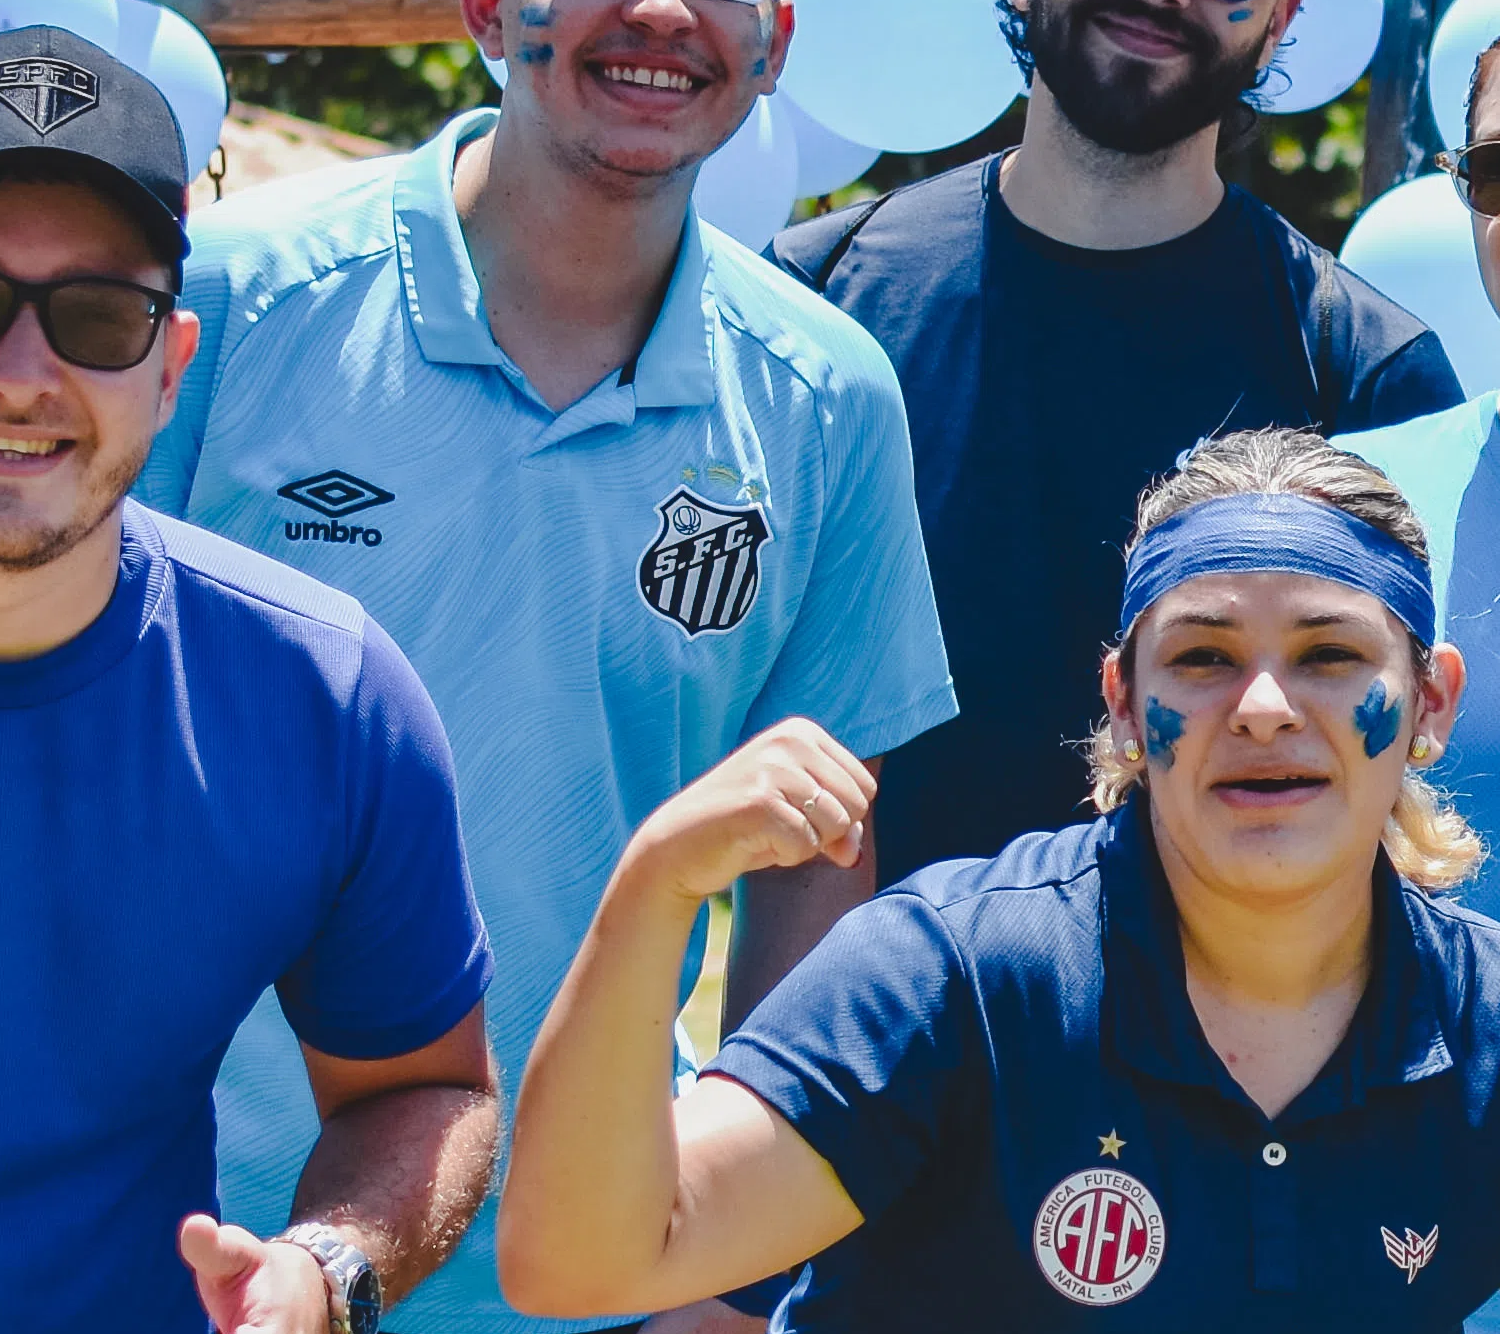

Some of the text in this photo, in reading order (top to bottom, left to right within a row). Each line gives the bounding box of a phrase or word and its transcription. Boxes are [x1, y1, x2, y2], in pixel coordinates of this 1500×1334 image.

[285, 519, 383, 548] umbro
[653, 520, 754, 579] S.F.C.
[1057, 1191, 1144, 1282] AFC
[1084, 1173, 1147, 1205] FUTEBOL
[1145, 1214, 1162, 1267] CLUBE
[1054, 1269, 1096, 1299] NATAL
[1112, 1280, 1134, 1298] RN
